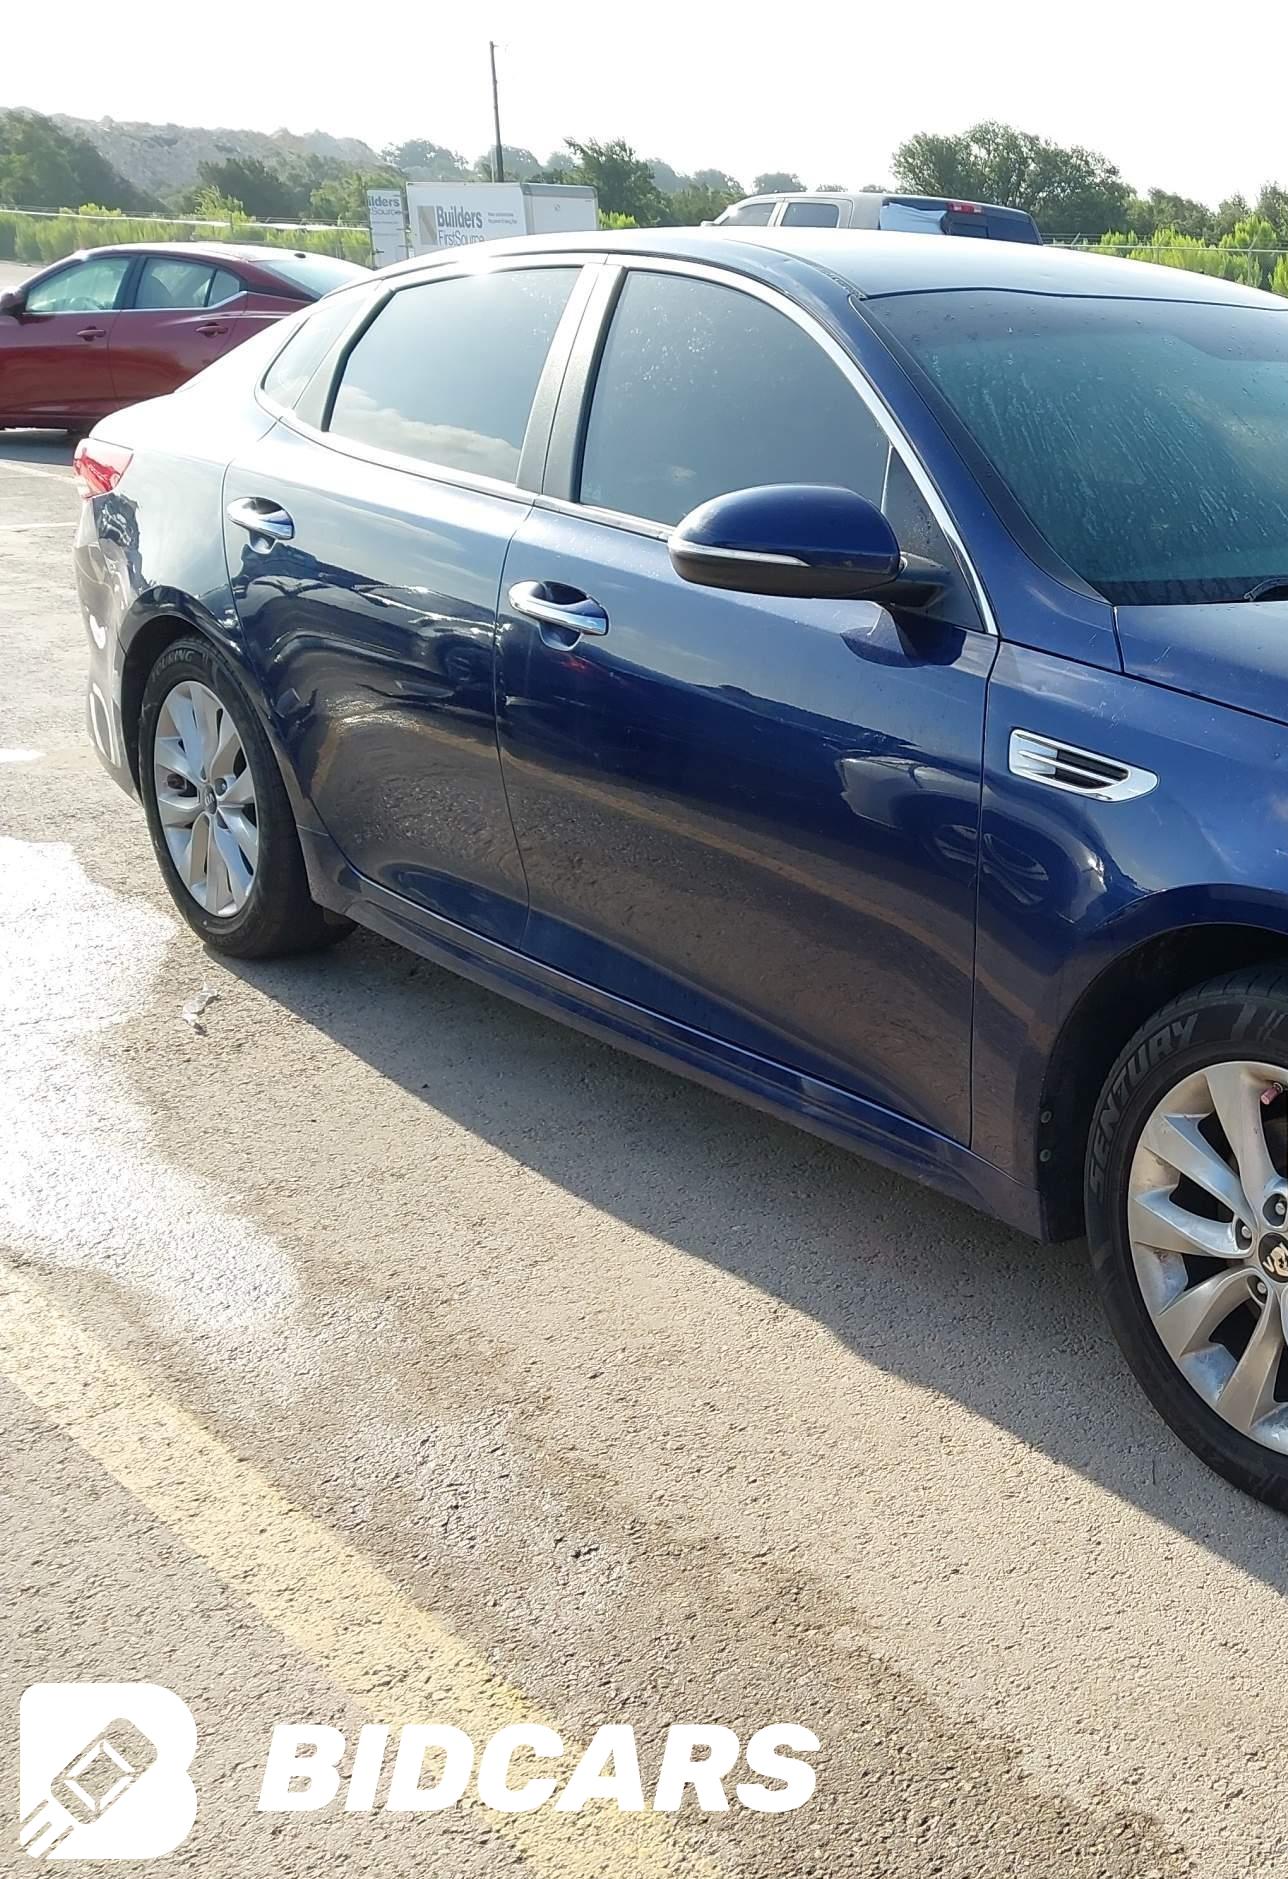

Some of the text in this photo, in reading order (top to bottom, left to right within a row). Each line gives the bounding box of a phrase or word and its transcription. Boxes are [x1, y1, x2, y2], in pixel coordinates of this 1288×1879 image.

[368, 195, 400, 207] ilders
[436, 205, 483, 229] Builders
[1090, 1012, 1199, 1201] SENTURY
